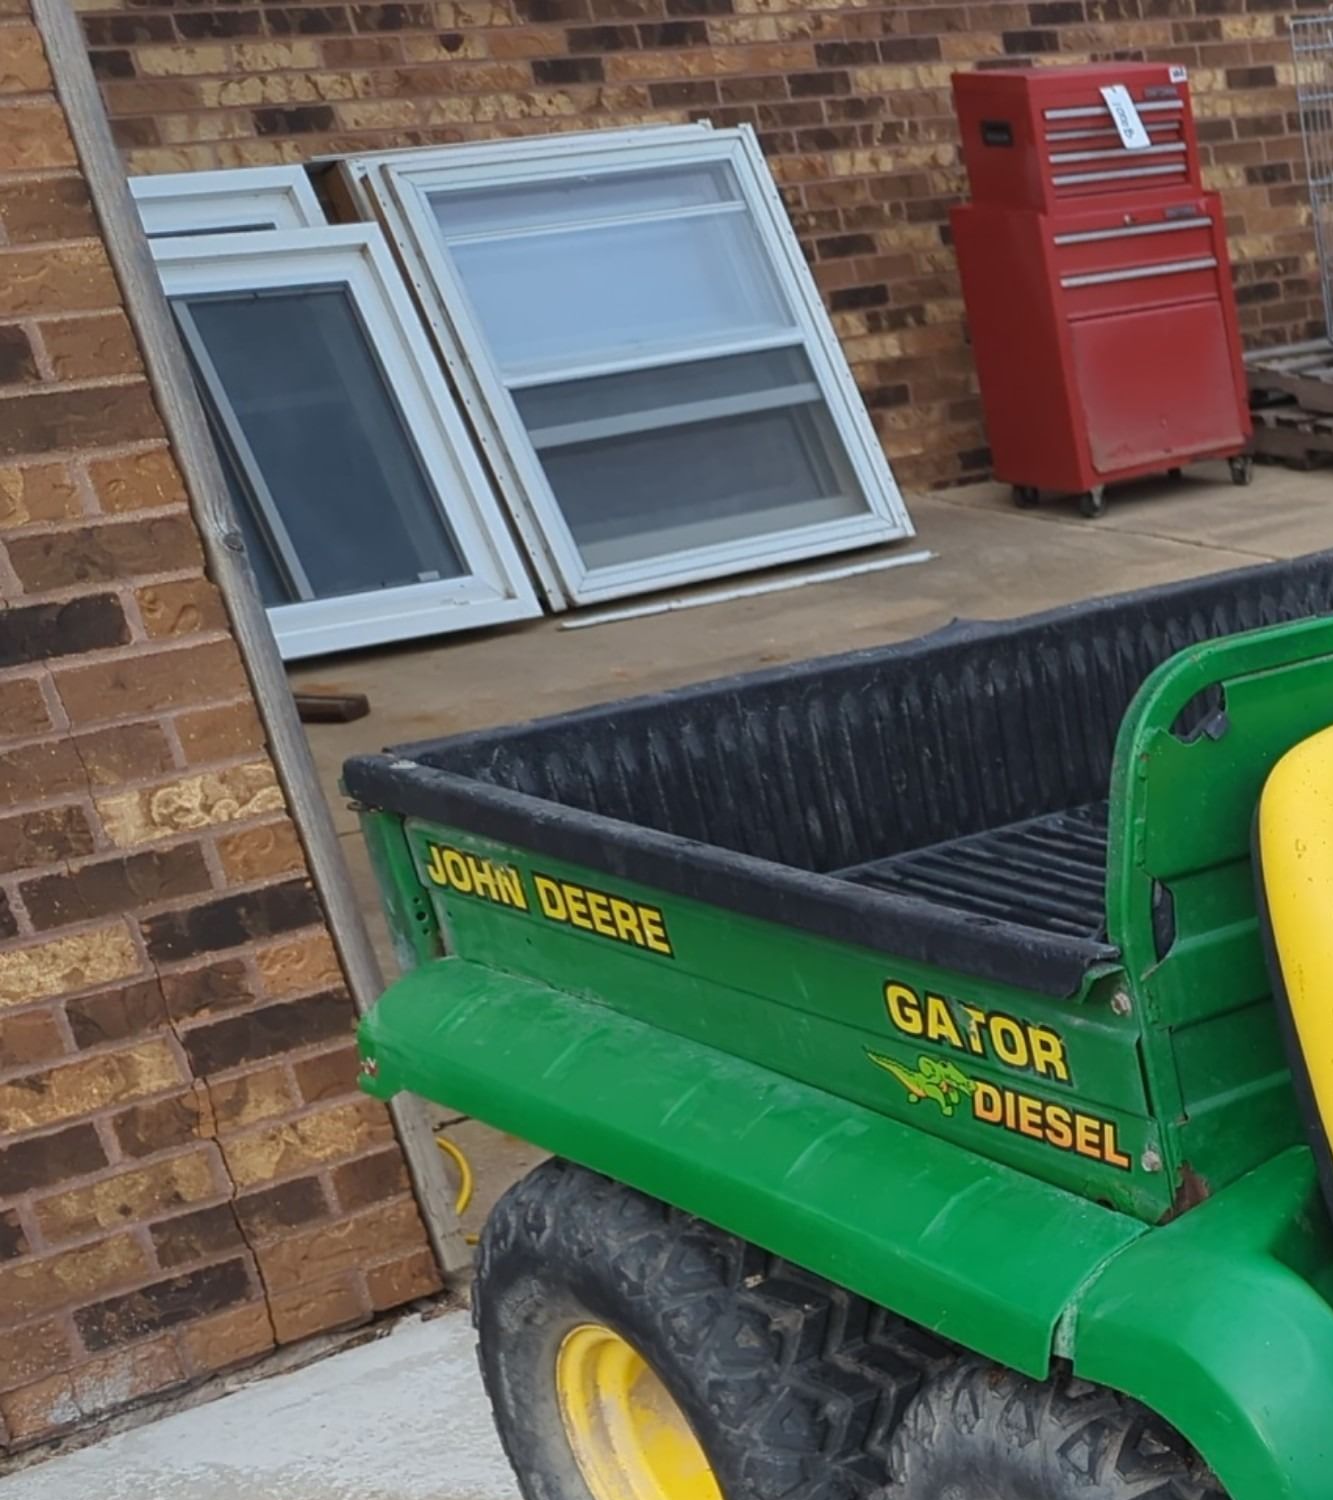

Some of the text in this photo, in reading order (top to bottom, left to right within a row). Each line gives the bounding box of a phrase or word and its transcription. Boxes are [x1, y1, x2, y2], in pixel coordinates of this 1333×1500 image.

[426, 844, 673, 955] JOHN DEERE
[884, 981, 1070, 1083] GATOR
[972, 1080, 1131, 1168] DIESEL
